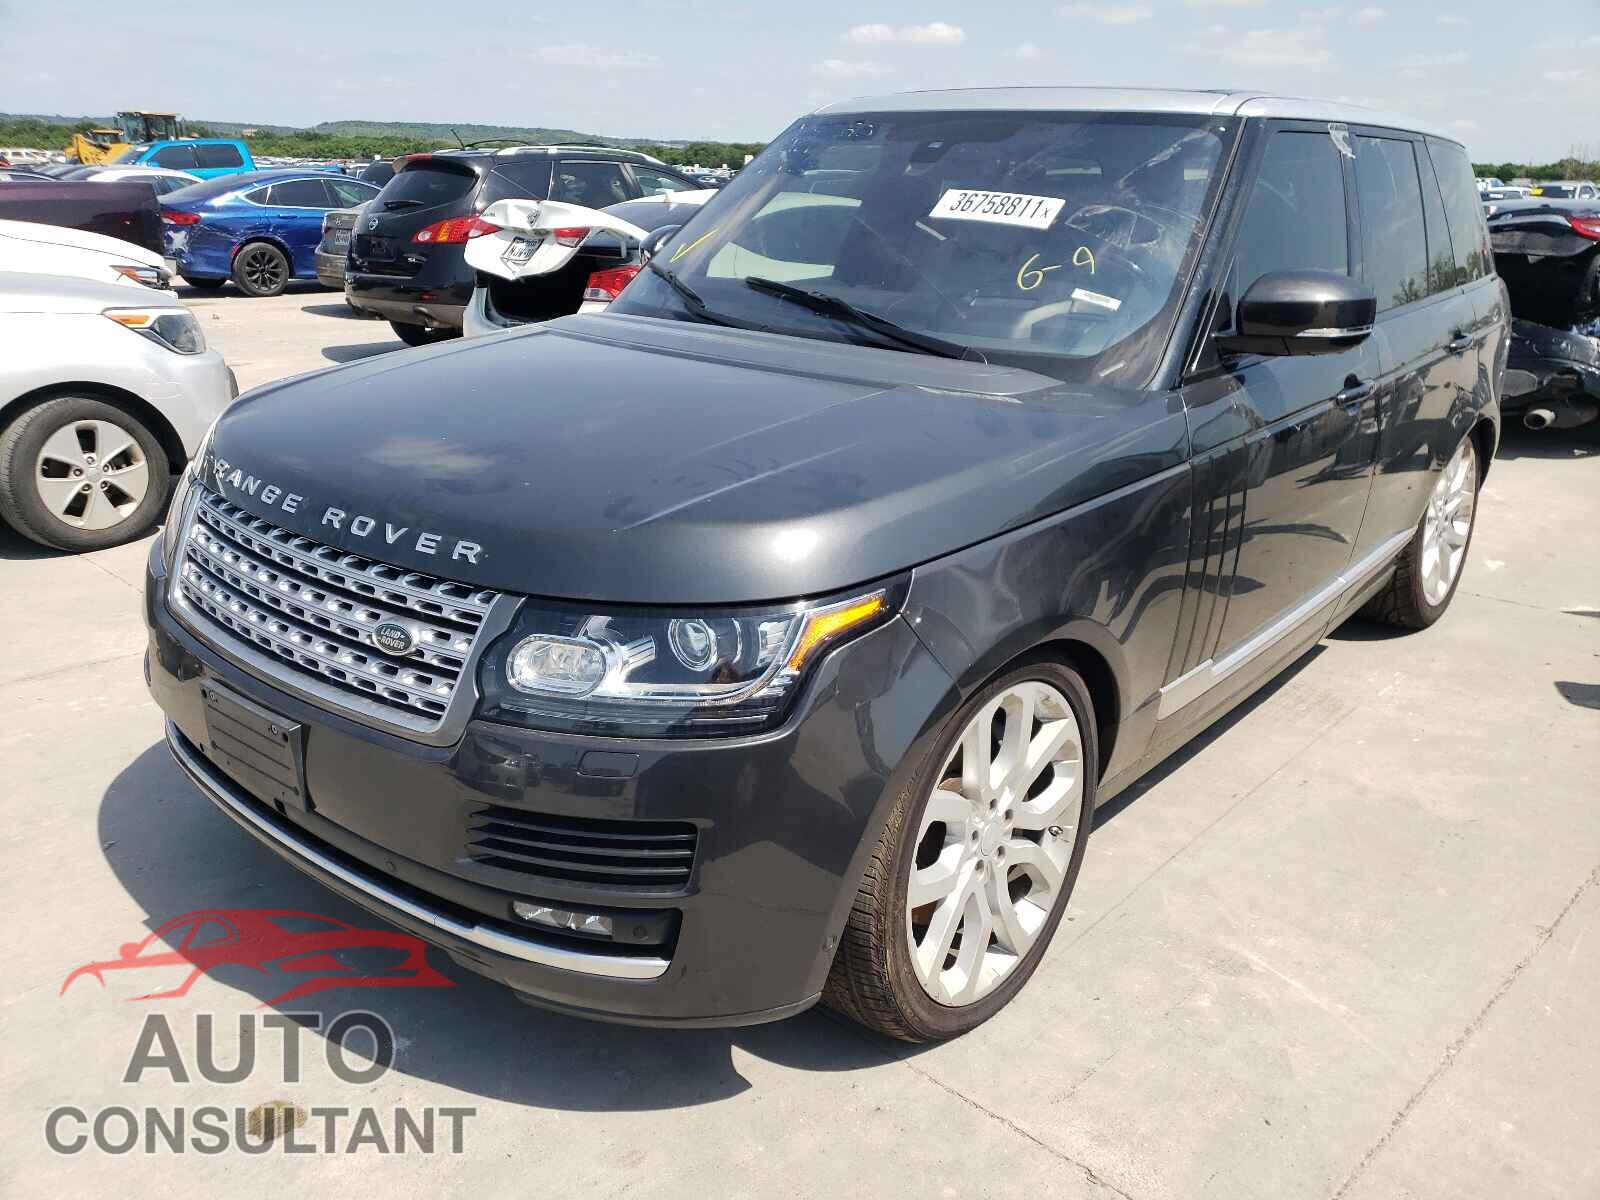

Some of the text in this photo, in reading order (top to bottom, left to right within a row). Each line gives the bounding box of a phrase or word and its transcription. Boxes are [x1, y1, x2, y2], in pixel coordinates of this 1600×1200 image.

[213, 458, 482, 564] RANGE ROVER
[380, 627, 401, 639] LAND
[380, 635, 405, 650] ROVER
